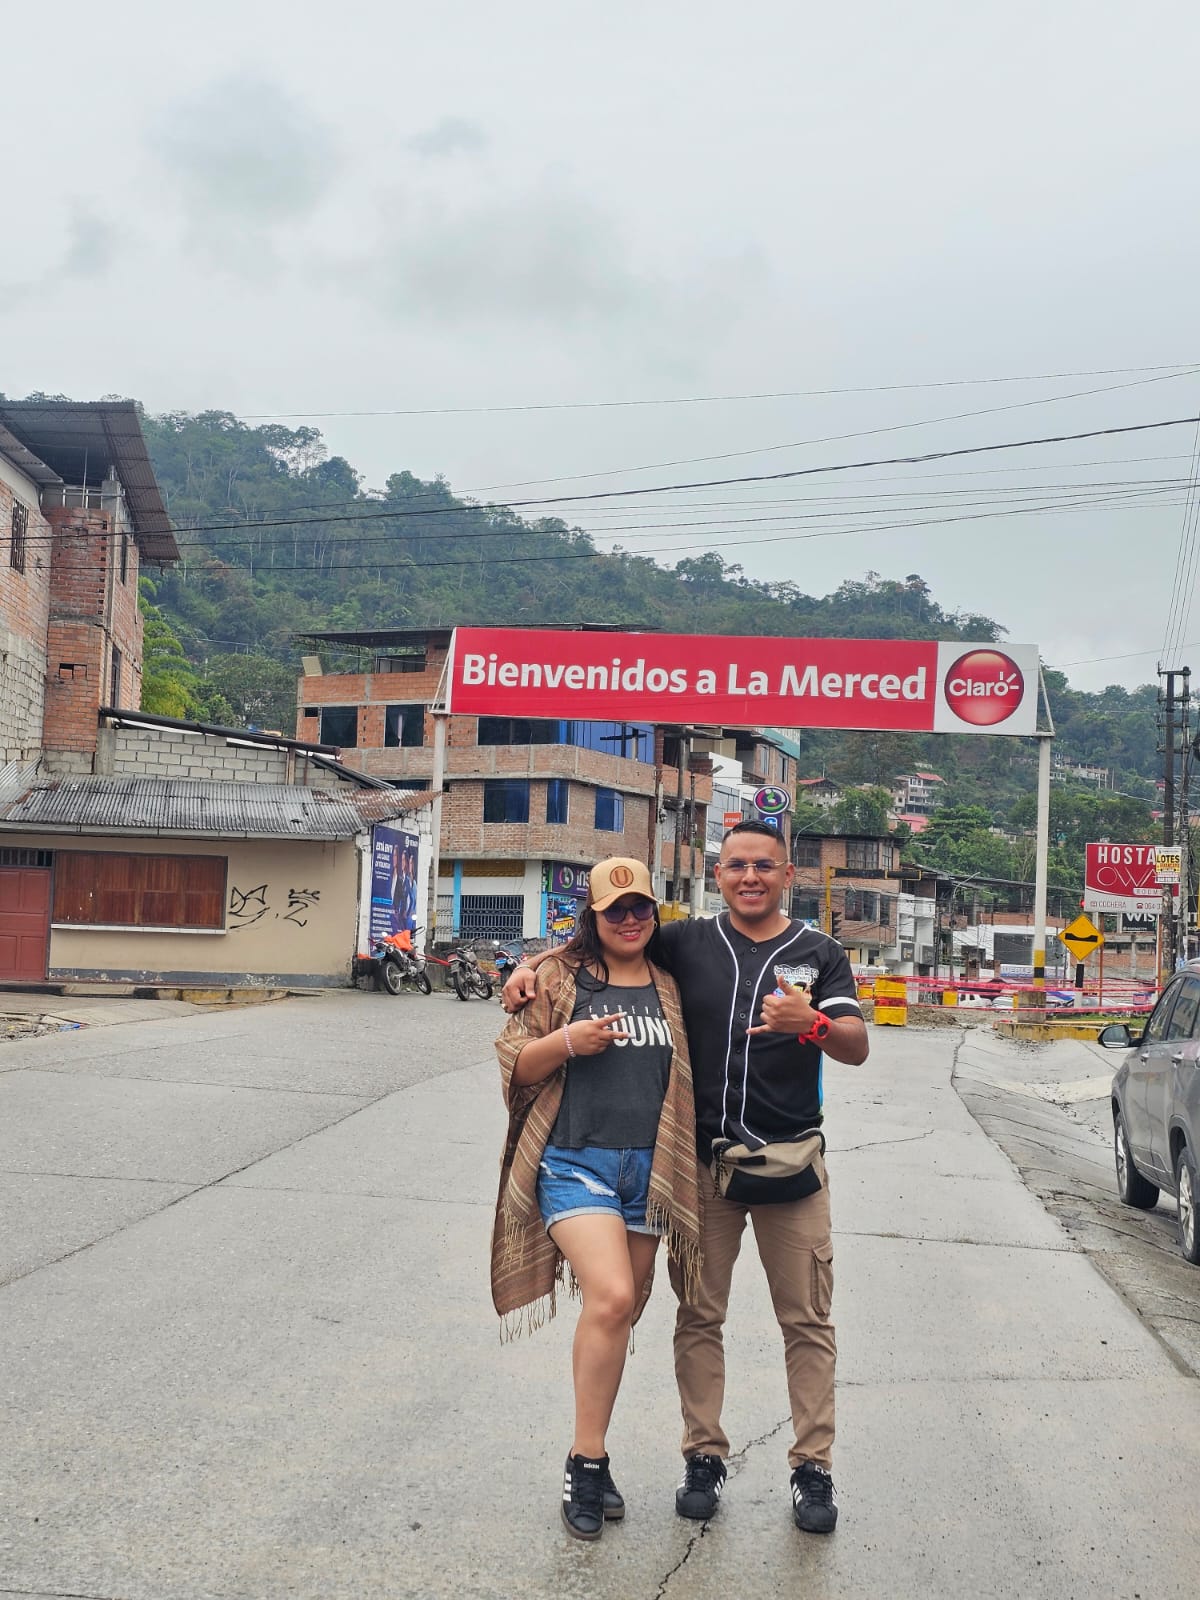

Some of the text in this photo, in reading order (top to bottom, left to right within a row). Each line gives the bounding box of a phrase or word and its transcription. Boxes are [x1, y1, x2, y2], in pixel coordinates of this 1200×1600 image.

[462, 653, 927, 700] Bienvenidos a La Merced
[949, 674, 1011, 697] Claro
[1098, 846, 1156, 866] HOSTA
[1156, 854, 1180, 863] LOTES
[576, 869, 590, 888] ins
